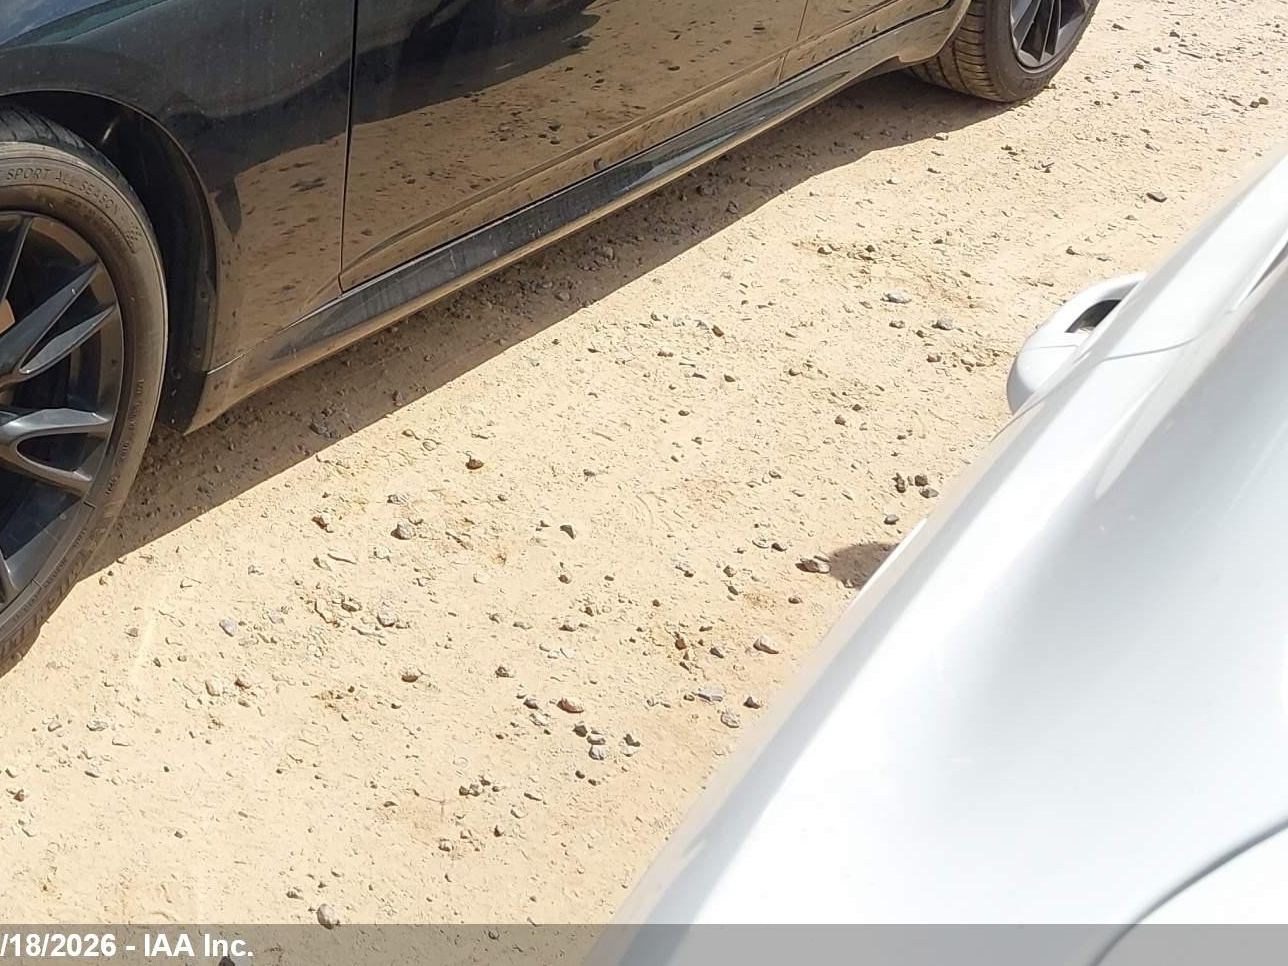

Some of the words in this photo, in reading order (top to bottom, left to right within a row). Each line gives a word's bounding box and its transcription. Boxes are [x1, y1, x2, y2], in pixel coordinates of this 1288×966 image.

[6, 167, 51, 181] SPORT
[54, 170, 75, 188] ALL
[78, 180, 120, 215] SEASON
